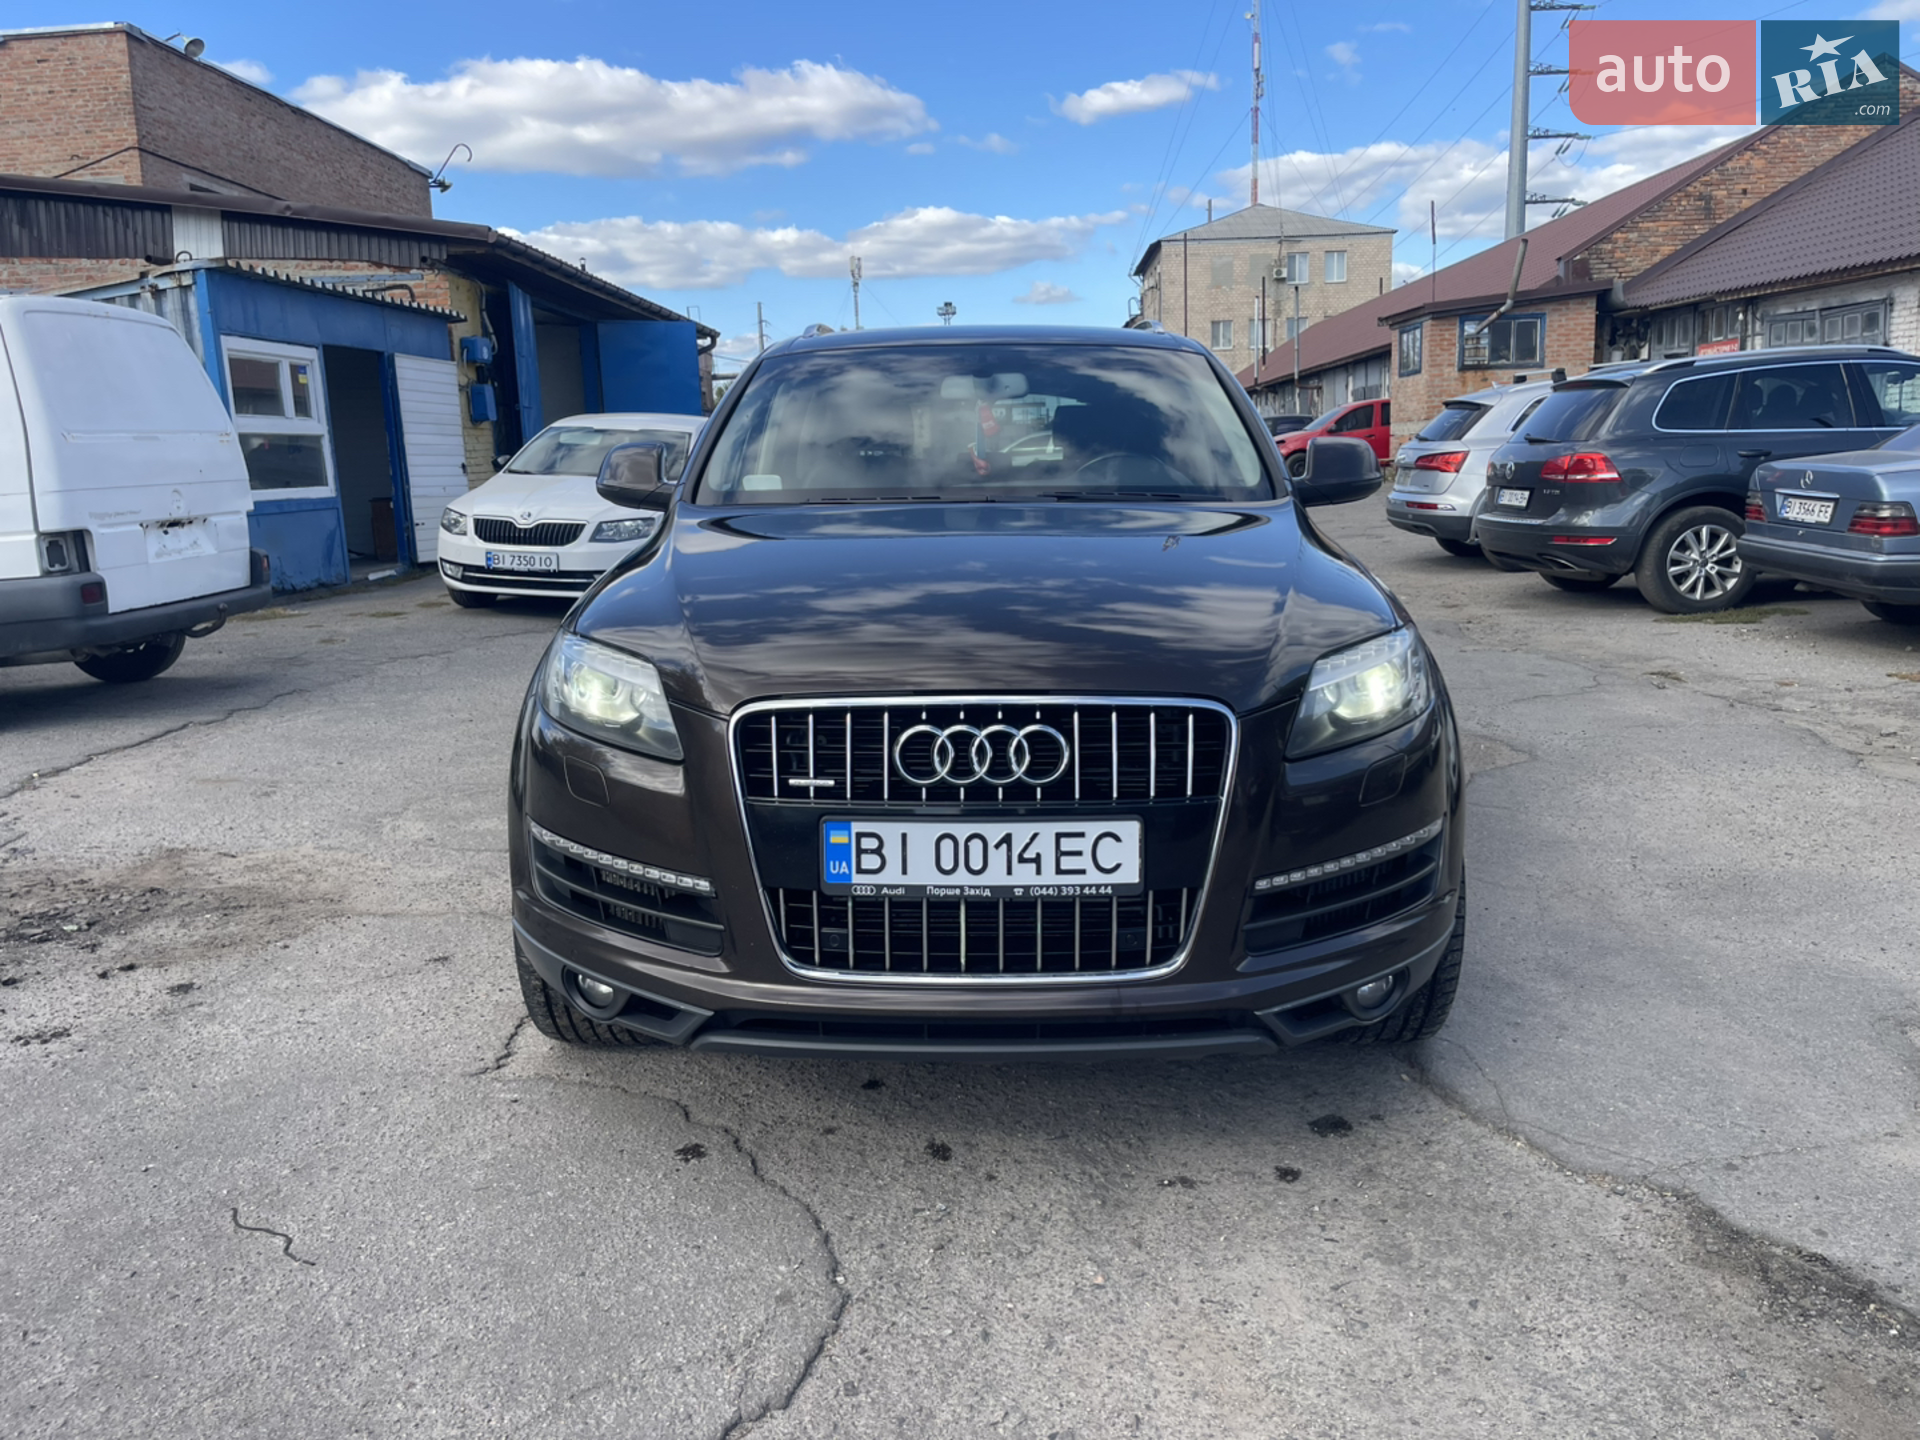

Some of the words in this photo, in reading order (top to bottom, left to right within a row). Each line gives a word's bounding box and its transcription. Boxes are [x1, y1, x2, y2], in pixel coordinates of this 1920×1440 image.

[493, 554, 505, 566] BI
[509, 554, 536, 567] 7350
[855, 832, 907, 875] BI
[830, 861, 849, 874] UA
[881, 886, 906, 895] Audi
[926, 886, 960, 897] Порше
[963, 886, 991, 897] Захід
[1029, 886, 1058, 897] (044)
[1060, 886, 1080, 896] 393
[1082, 886, 1097, 895] 44
[1098, 885, 1113, 894] 44
